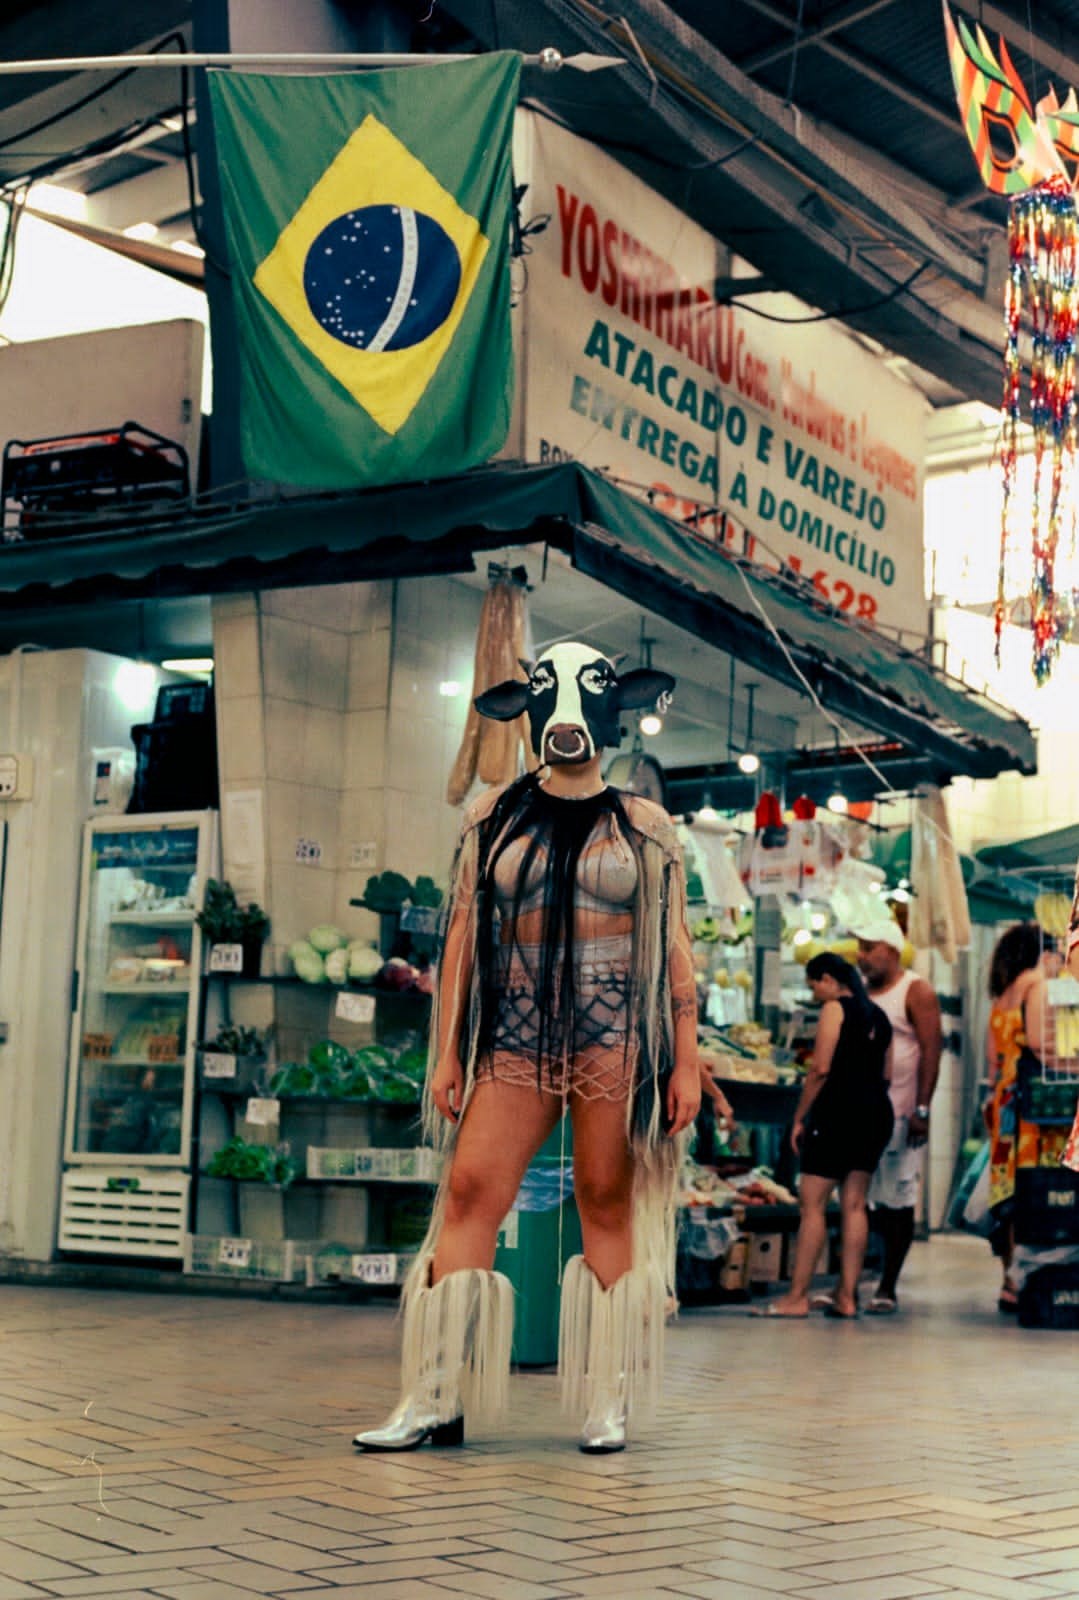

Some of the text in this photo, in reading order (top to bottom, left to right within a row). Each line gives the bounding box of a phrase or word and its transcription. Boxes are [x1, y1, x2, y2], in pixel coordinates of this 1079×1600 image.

[570, 375, 719, 493] ENTREGA
[757, 487, 895, 587] DOMICÍLIO
[584, 319, 887, 531] ATACADO E VAREJO
